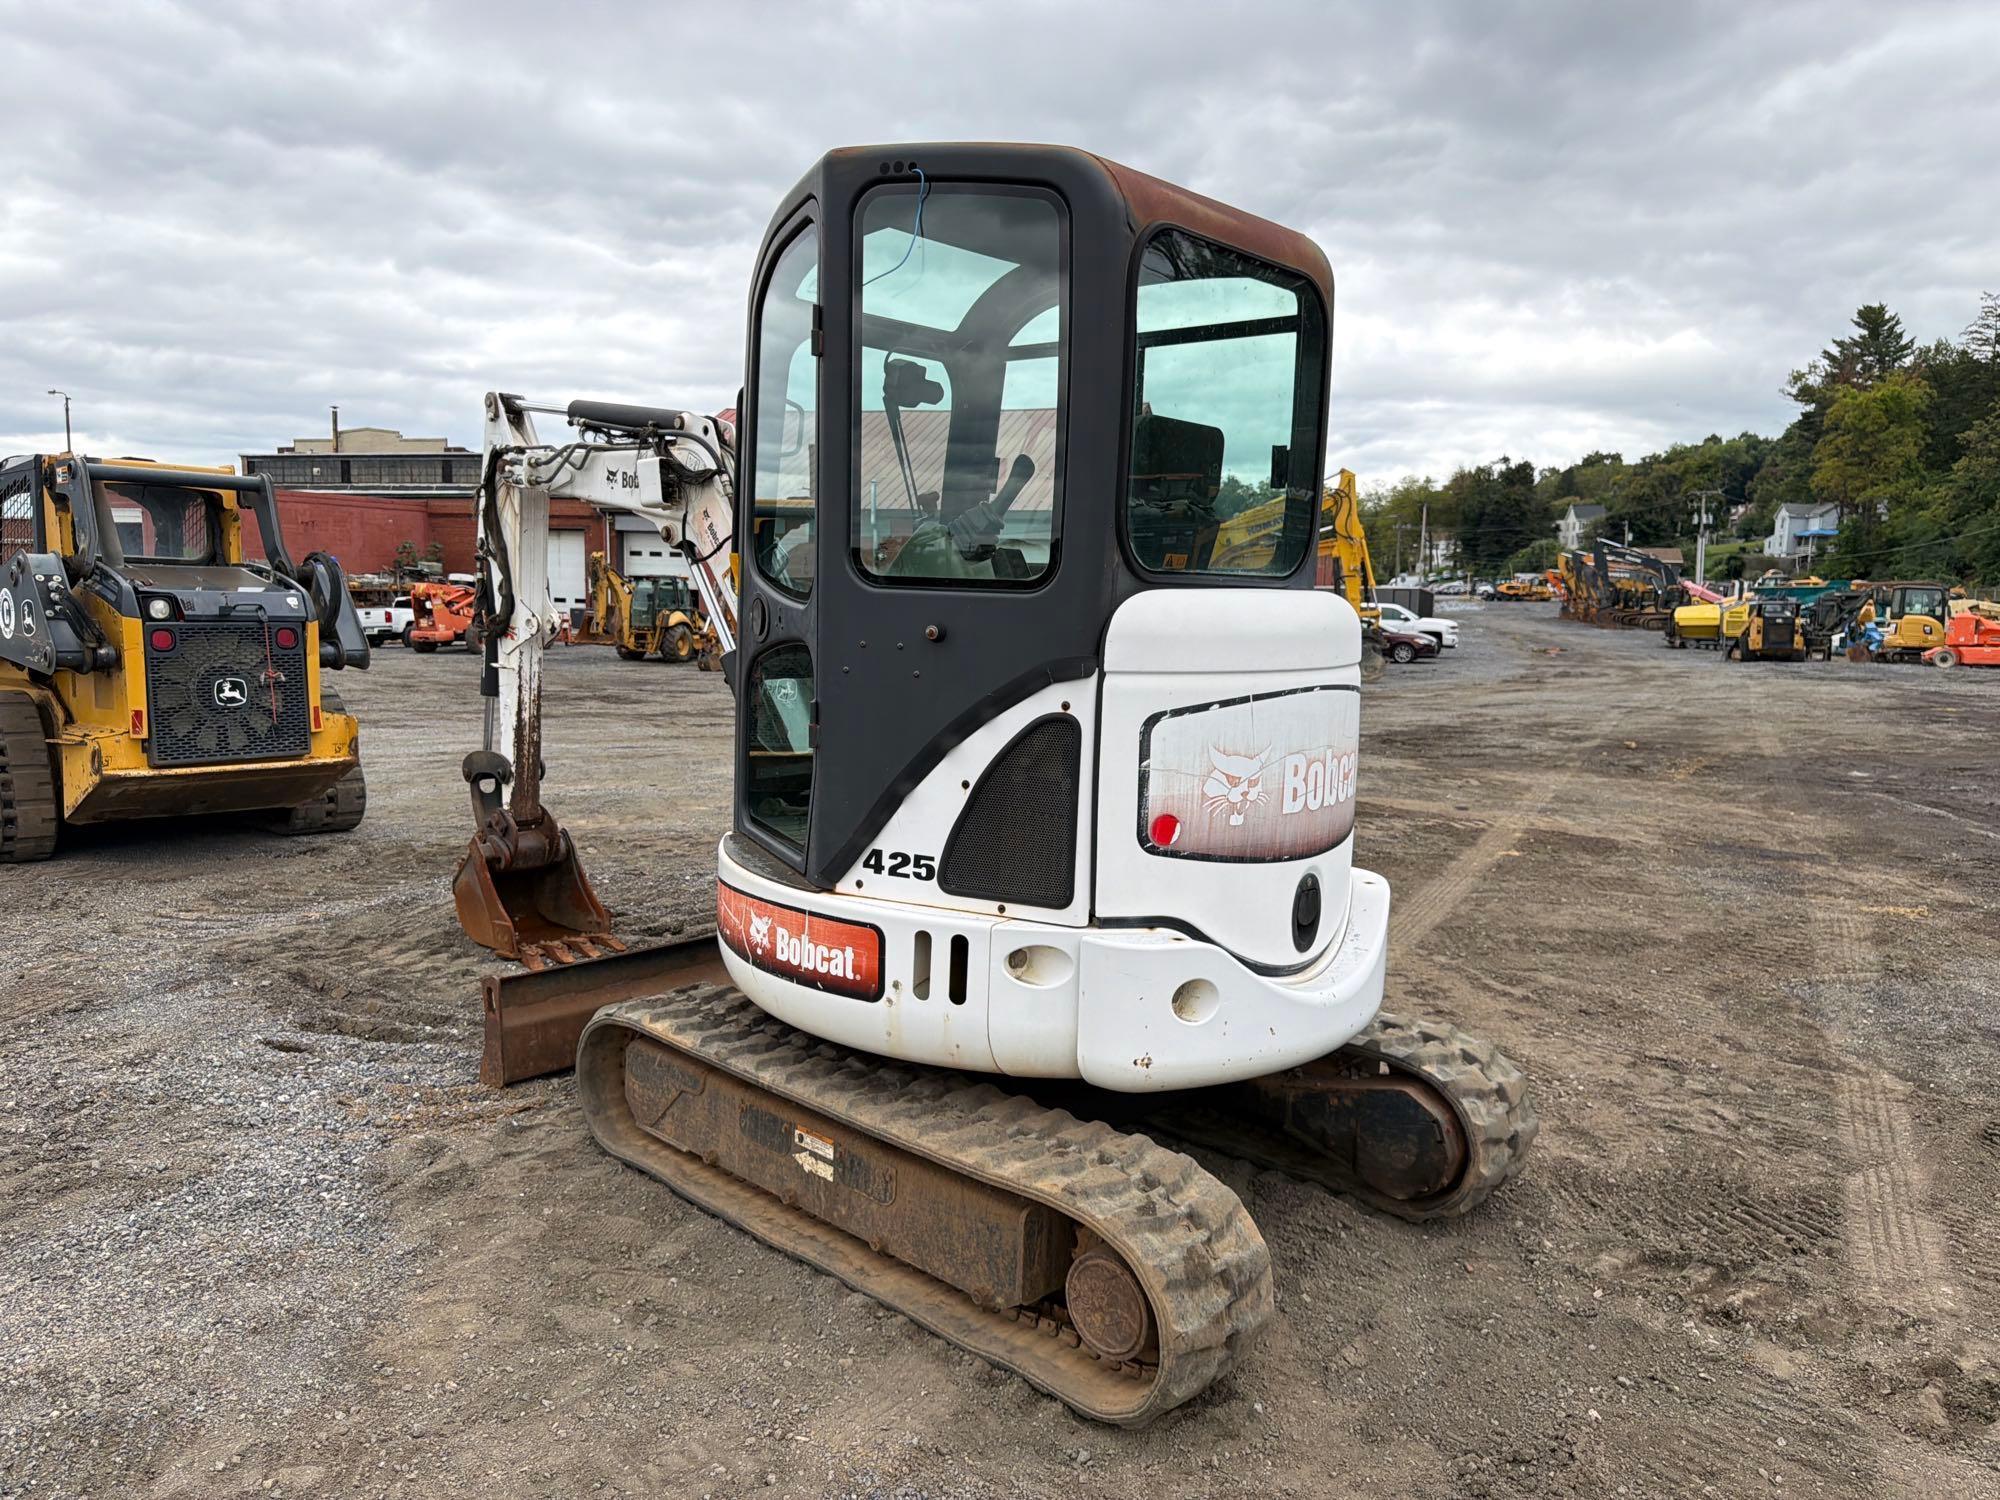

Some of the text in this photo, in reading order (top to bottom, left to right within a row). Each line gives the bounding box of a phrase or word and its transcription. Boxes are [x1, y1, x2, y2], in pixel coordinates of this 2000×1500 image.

[622, 472, 640, 488] Bob
[707, 522, 721, 549] Bobca
[1283, 749, 1354, 814] Bobca
[862, 848, 935, 881] 425
[776, 927, 855, 979] Bobcat
